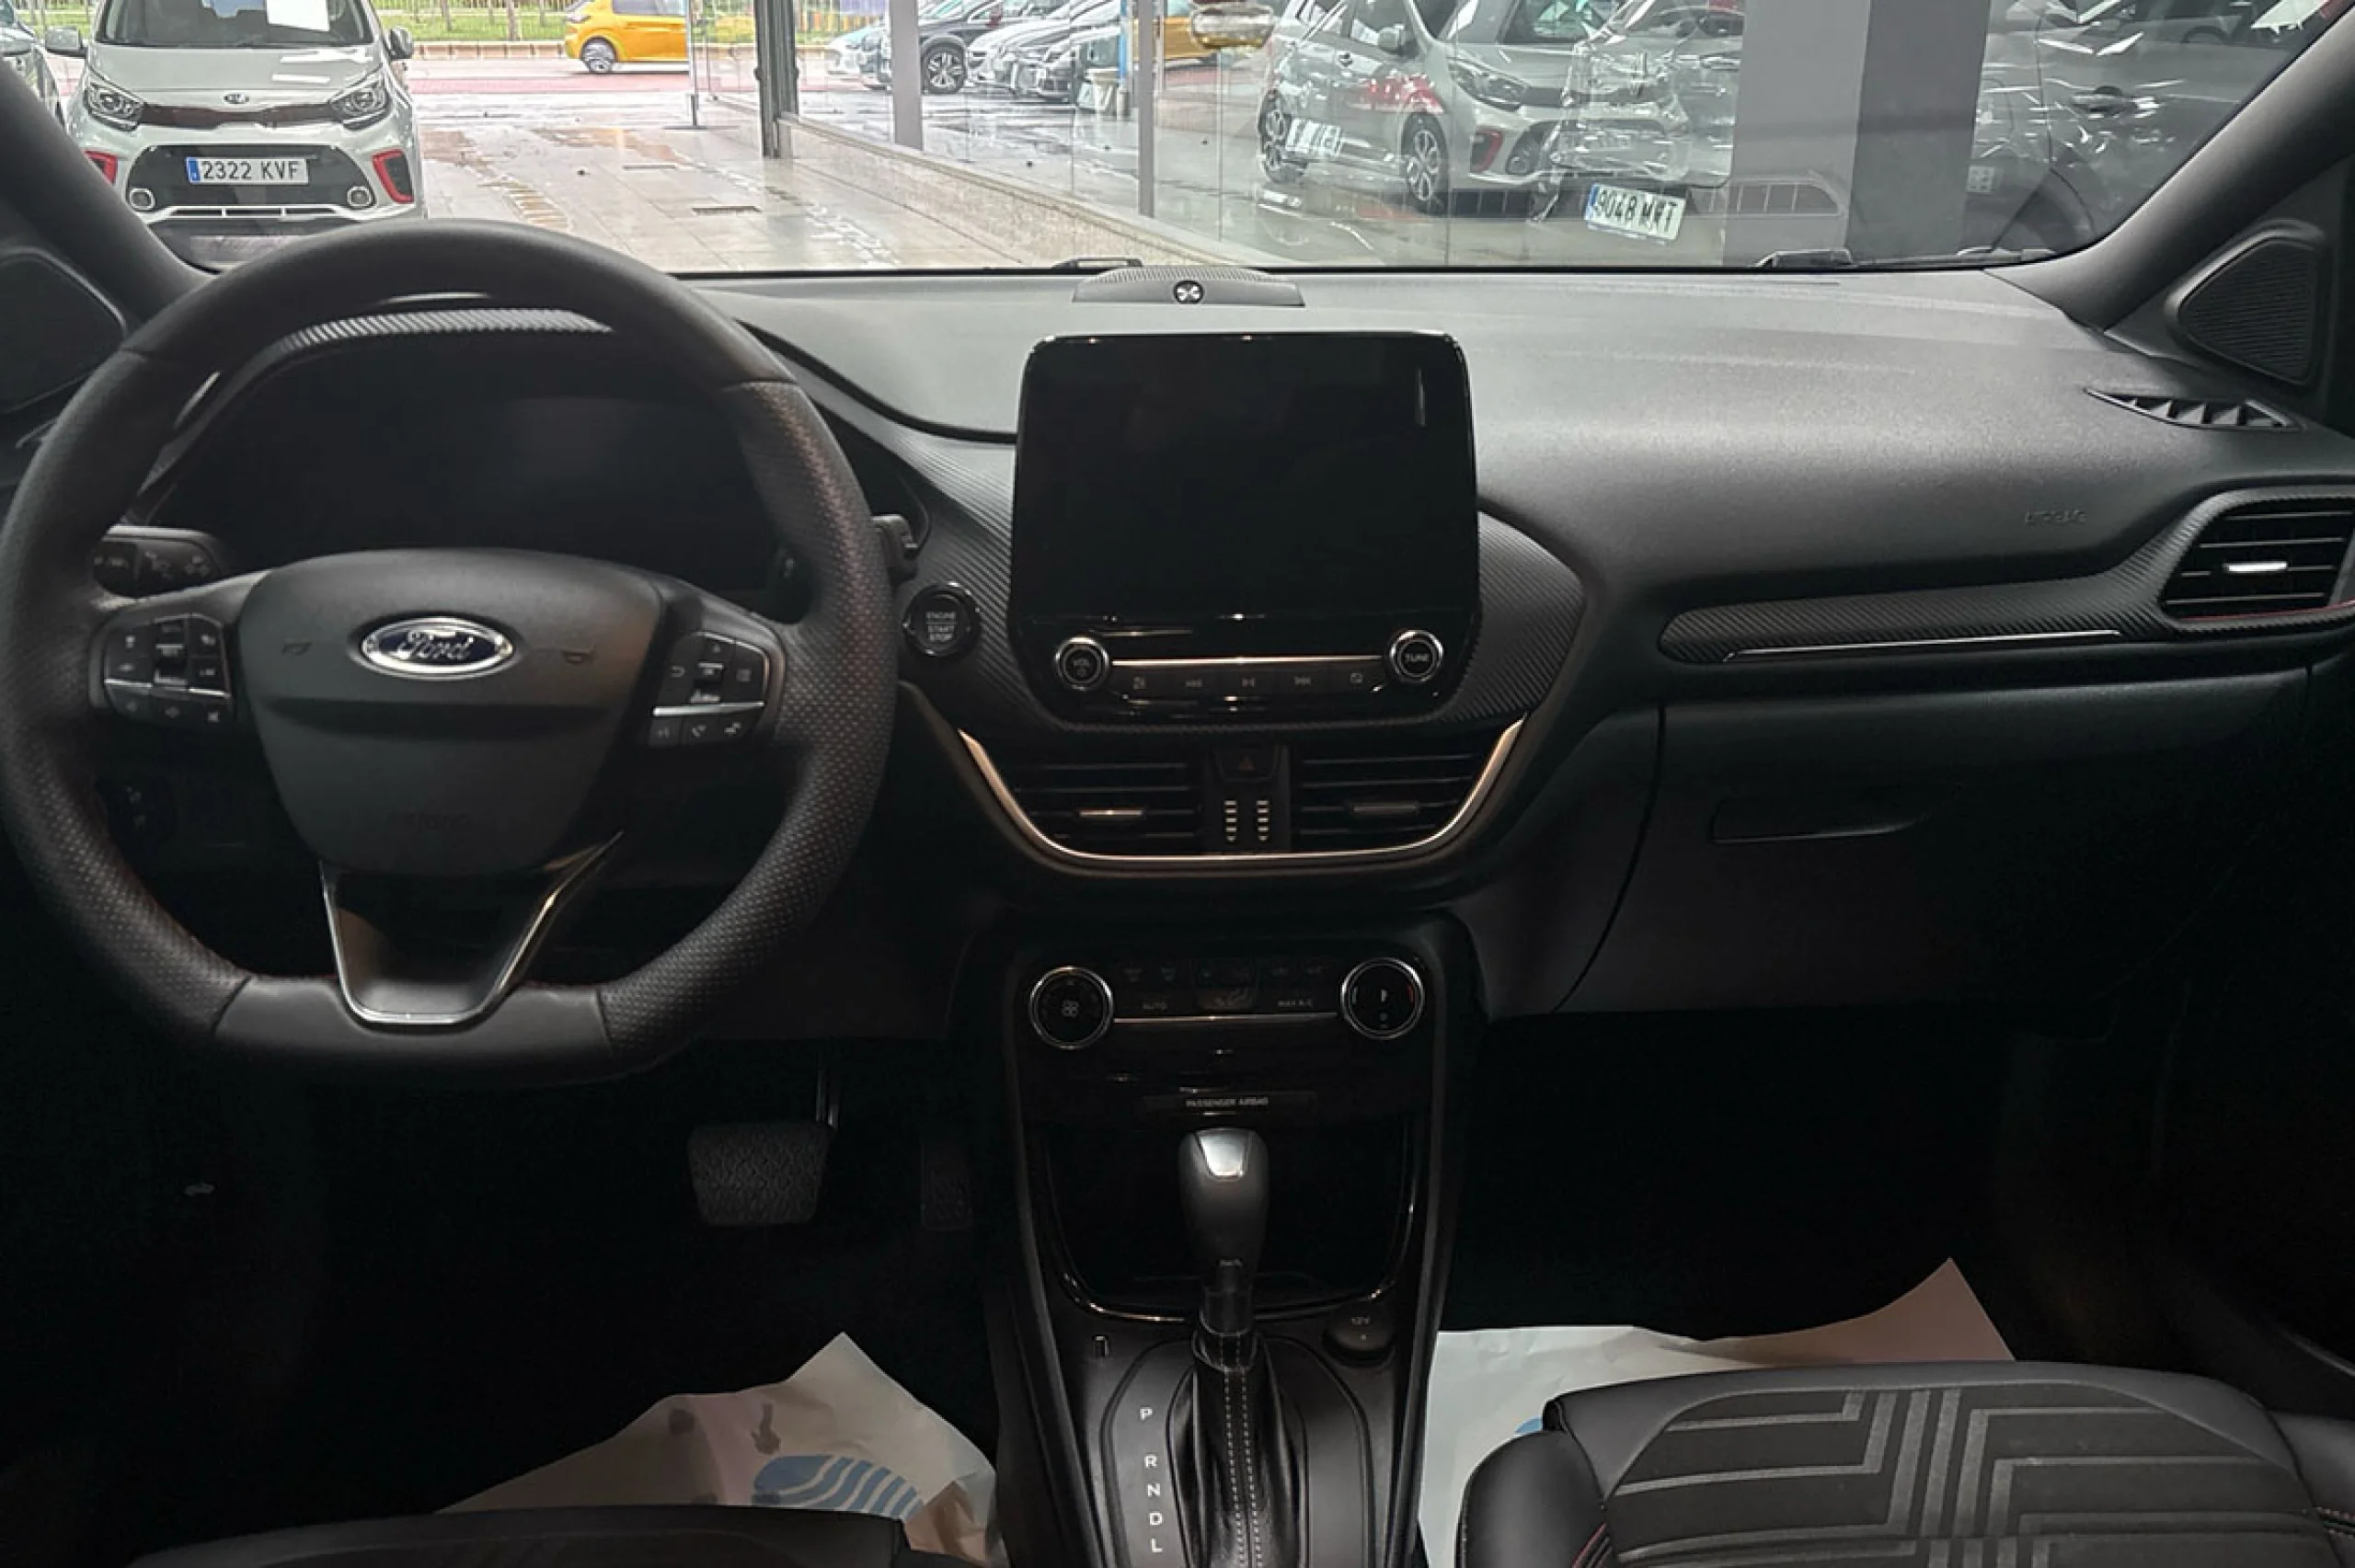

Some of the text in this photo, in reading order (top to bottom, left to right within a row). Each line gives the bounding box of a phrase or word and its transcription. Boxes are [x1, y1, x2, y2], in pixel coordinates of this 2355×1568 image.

[201, 160, 299, 179] 2322 KVF
[1593, 189, 1637, 221] 9048
[390, 631, 475, 659] Ford
[929, 634, 953, 642] STOP
[1140, 1407, 1163, 1552] P R N D L
